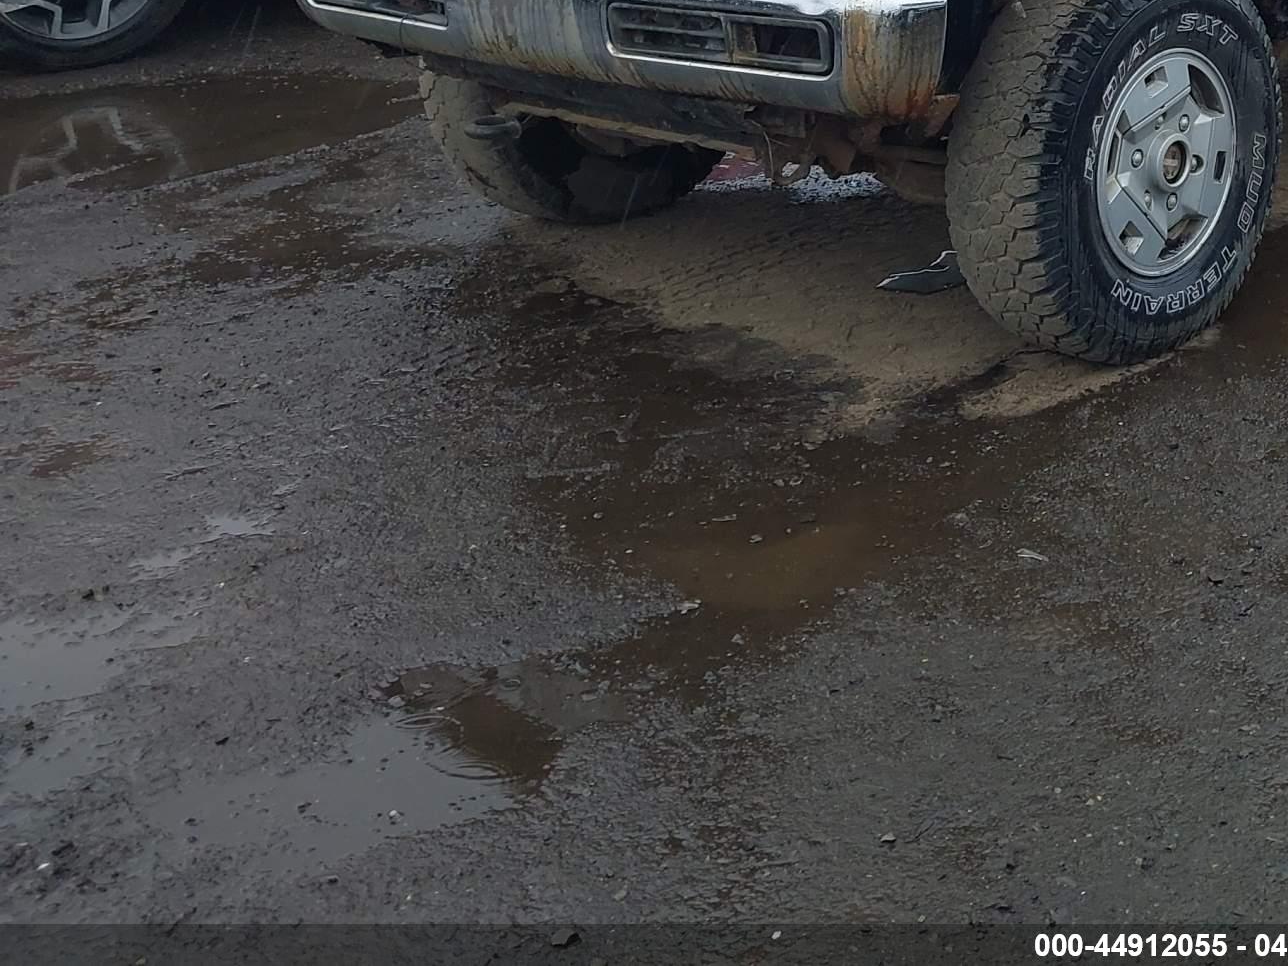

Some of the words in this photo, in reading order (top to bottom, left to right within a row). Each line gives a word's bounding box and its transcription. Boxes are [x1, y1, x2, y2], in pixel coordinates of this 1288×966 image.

[1083, 25, 1167, 182] RADIAL
[1176, 12, 1239, 45] SXT
[1236, 134, 1267, 233] MUD
[1110, 245, 1237, 315] TERRAIN
